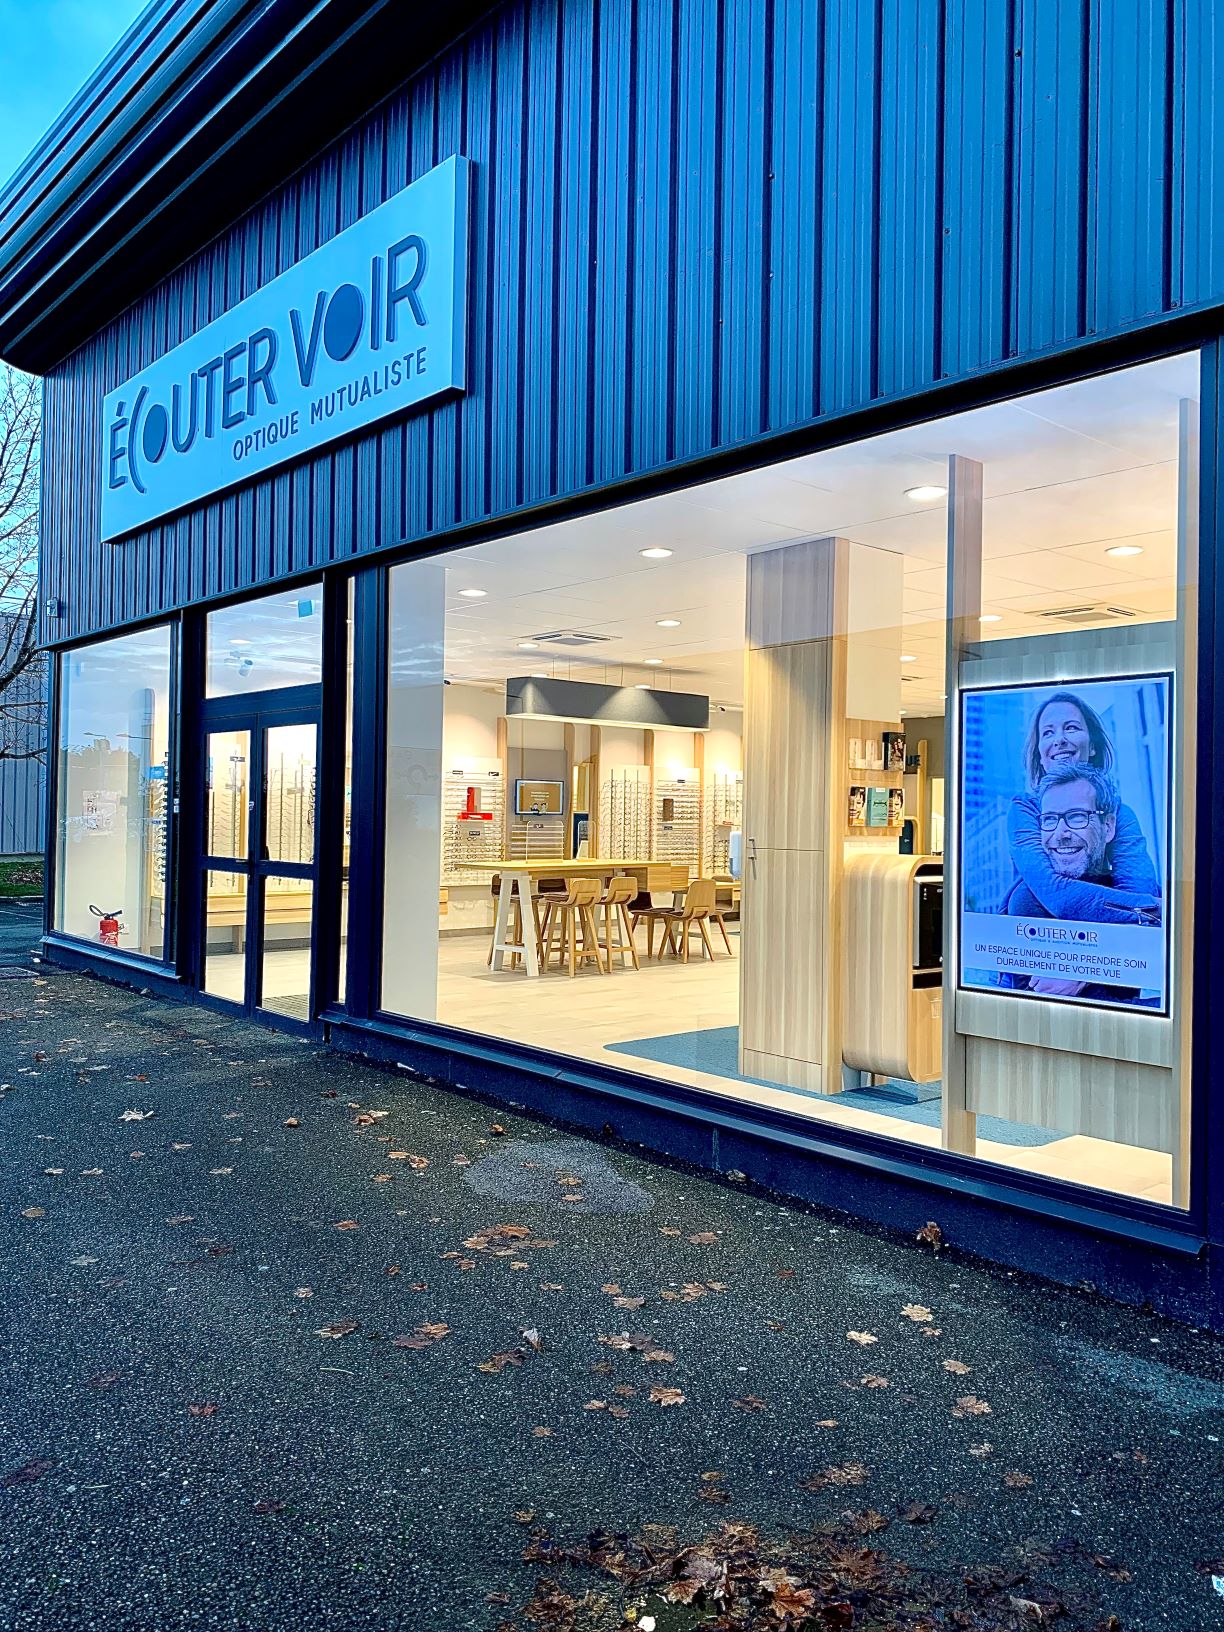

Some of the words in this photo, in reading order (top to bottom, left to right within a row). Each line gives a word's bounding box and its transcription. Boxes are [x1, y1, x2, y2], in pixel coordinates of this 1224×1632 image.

[289, 234, 428, 388] VOIR
[232, 411, 300, 461] OPTIQUE
[310, 346, 428, 425] MUTUALISTE
[1069, 929, 1098, 943] VOIR
[975, 943, 987, 952] UN
[988, 945, 1019, 956] ESPACE
[1020, 948, 1052, 959] UNIQUE
[1053, 951, 1079, 963] POUR
[1080, 954, 1122, 967] PRENDRE
[1123, 958, 1147, 969] SOIN
[996, 956, 1056, 971] DURABLEMENT
[1058, 963, 1071, 973] DE
[1072, 965, 1101, 977] VOTRE
[1102, 968, 1121, 979] VUE
